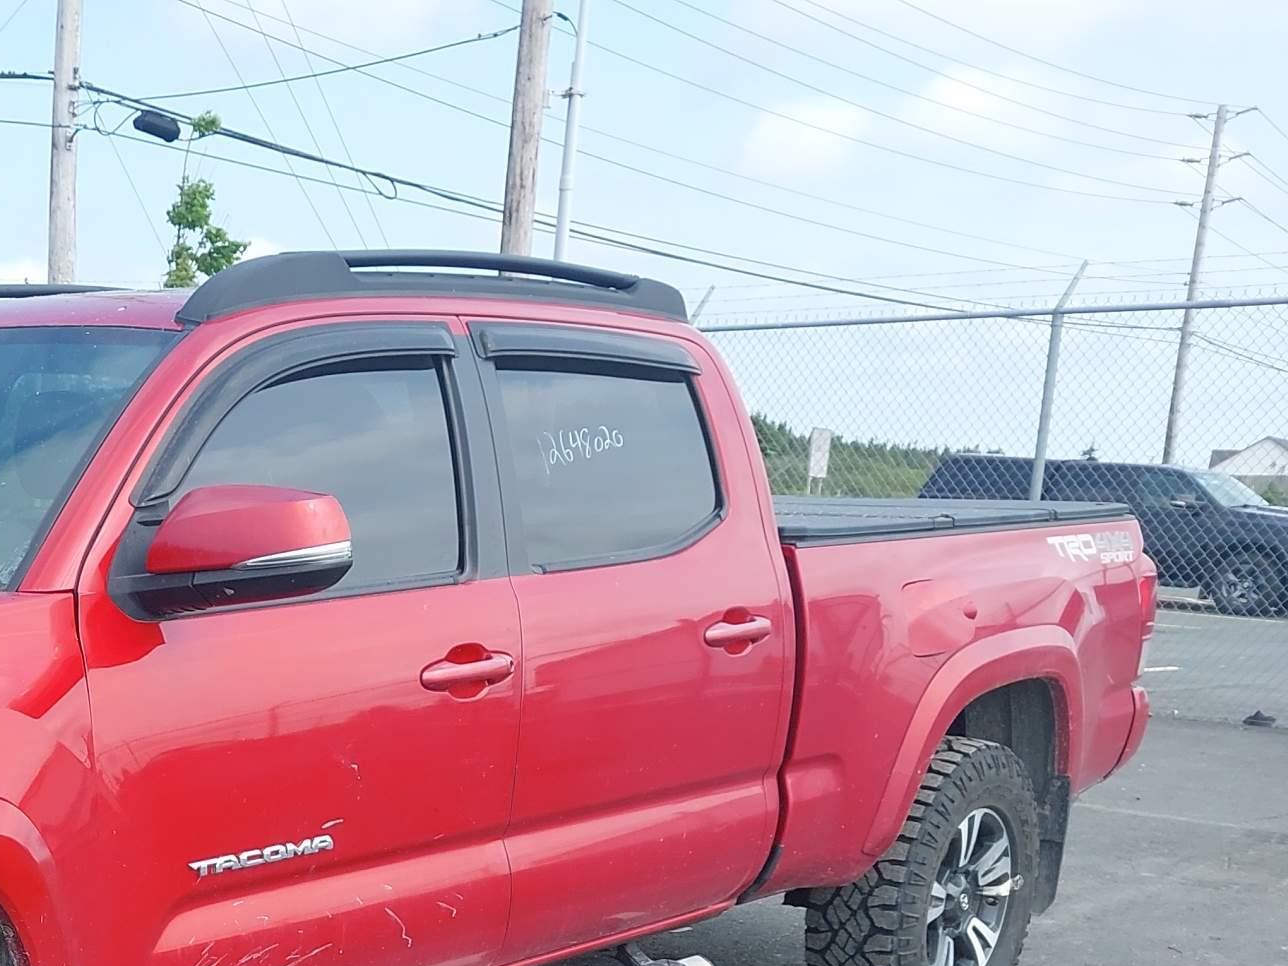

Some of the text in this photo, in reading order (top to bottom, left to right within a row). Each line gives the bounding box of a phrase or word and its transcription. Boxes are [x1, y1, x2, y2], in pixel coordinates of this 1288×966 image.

[537, 425, 624, 475] 12648020
[1045, 533, 1097, 562] TRD
[1100, 551, 1134, 564] SPORT
[187, 834, 335, 877] TACOMA
